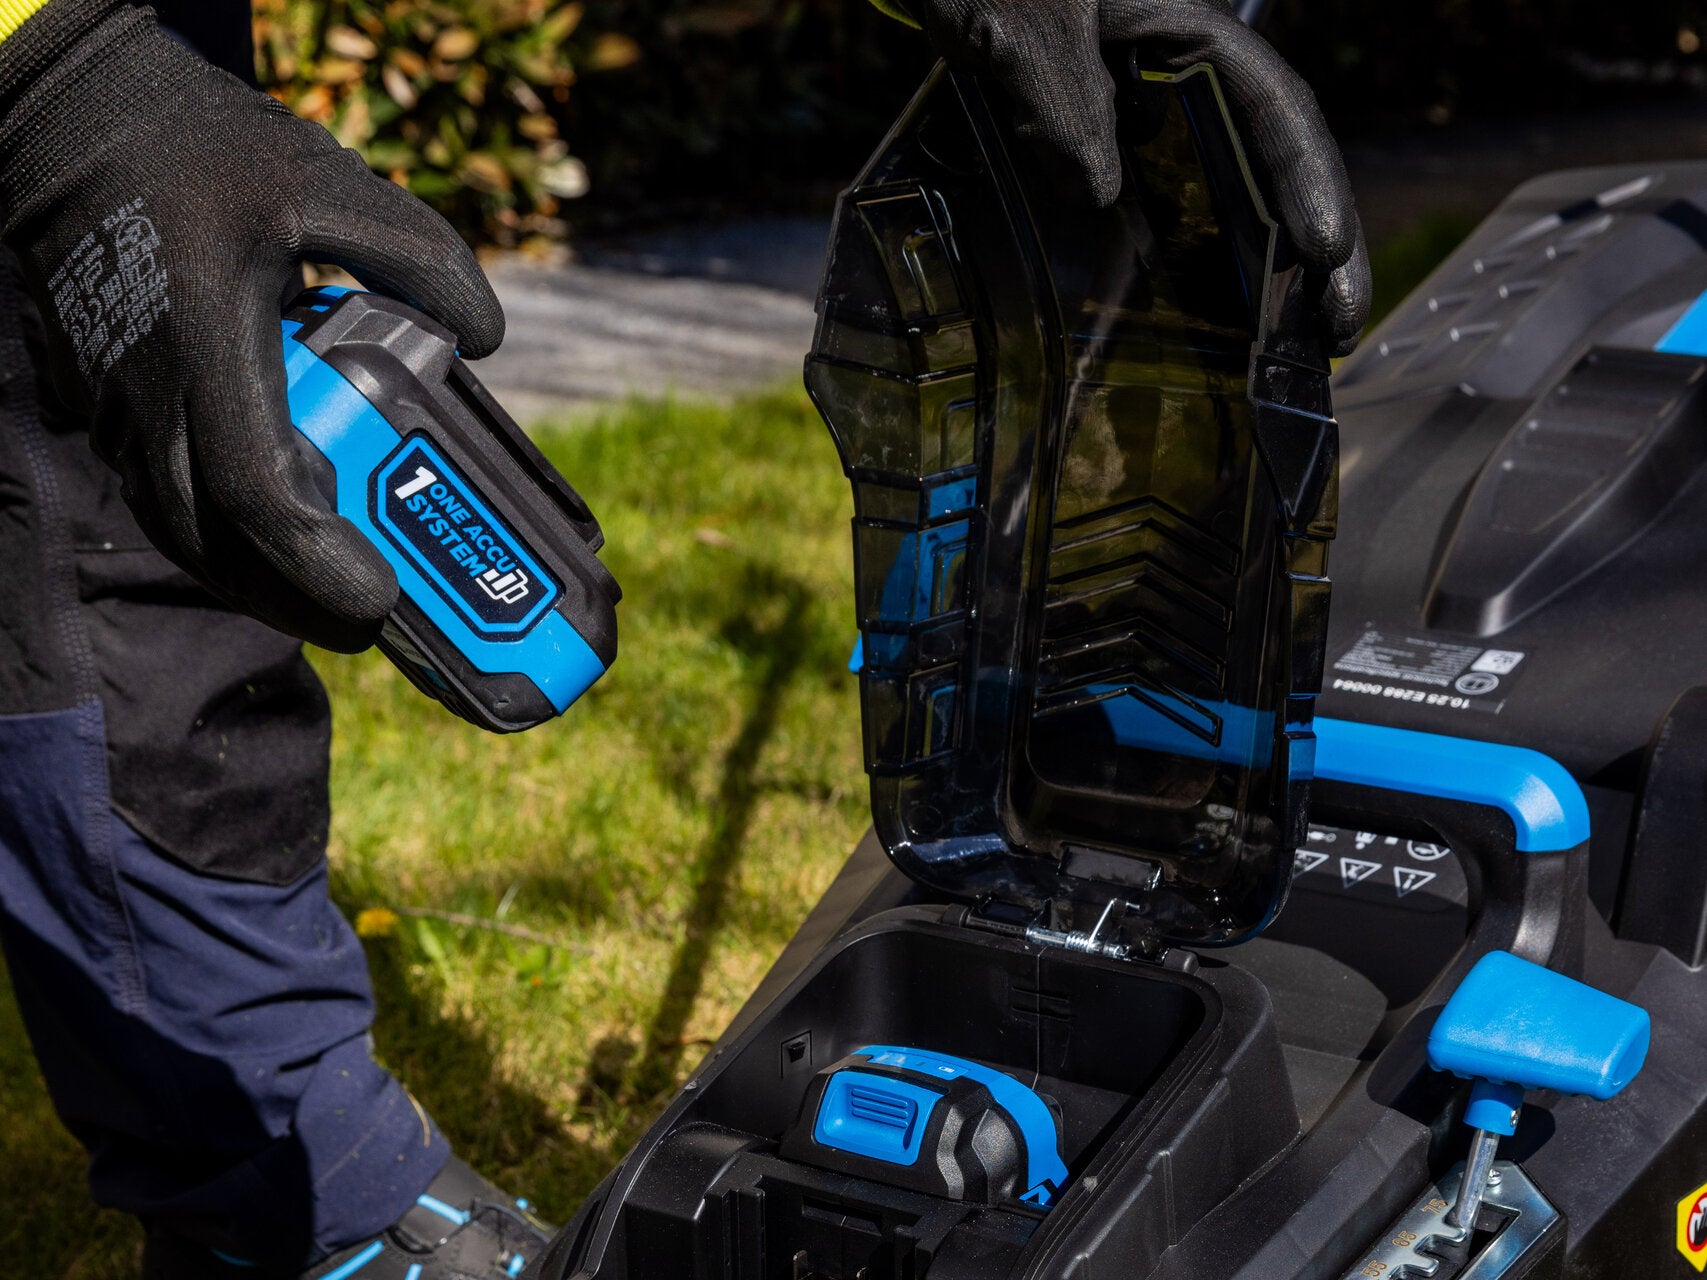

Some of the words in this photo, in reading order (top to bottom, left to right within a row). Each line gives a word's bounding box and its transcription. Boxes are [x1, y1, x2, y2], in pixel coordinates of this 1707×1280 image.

[394, 466, 437, 500] 1
[429, 483, 471, 524] ONE
[463, 525, 516, 573] ACCU
[406, 494, 488, 577] SYSTEM
[1420, 1198, 1448, 1214] 75
[1392, 1230, 1418, 1247] 65
[1361, 1259, 1388, 1278] 55
